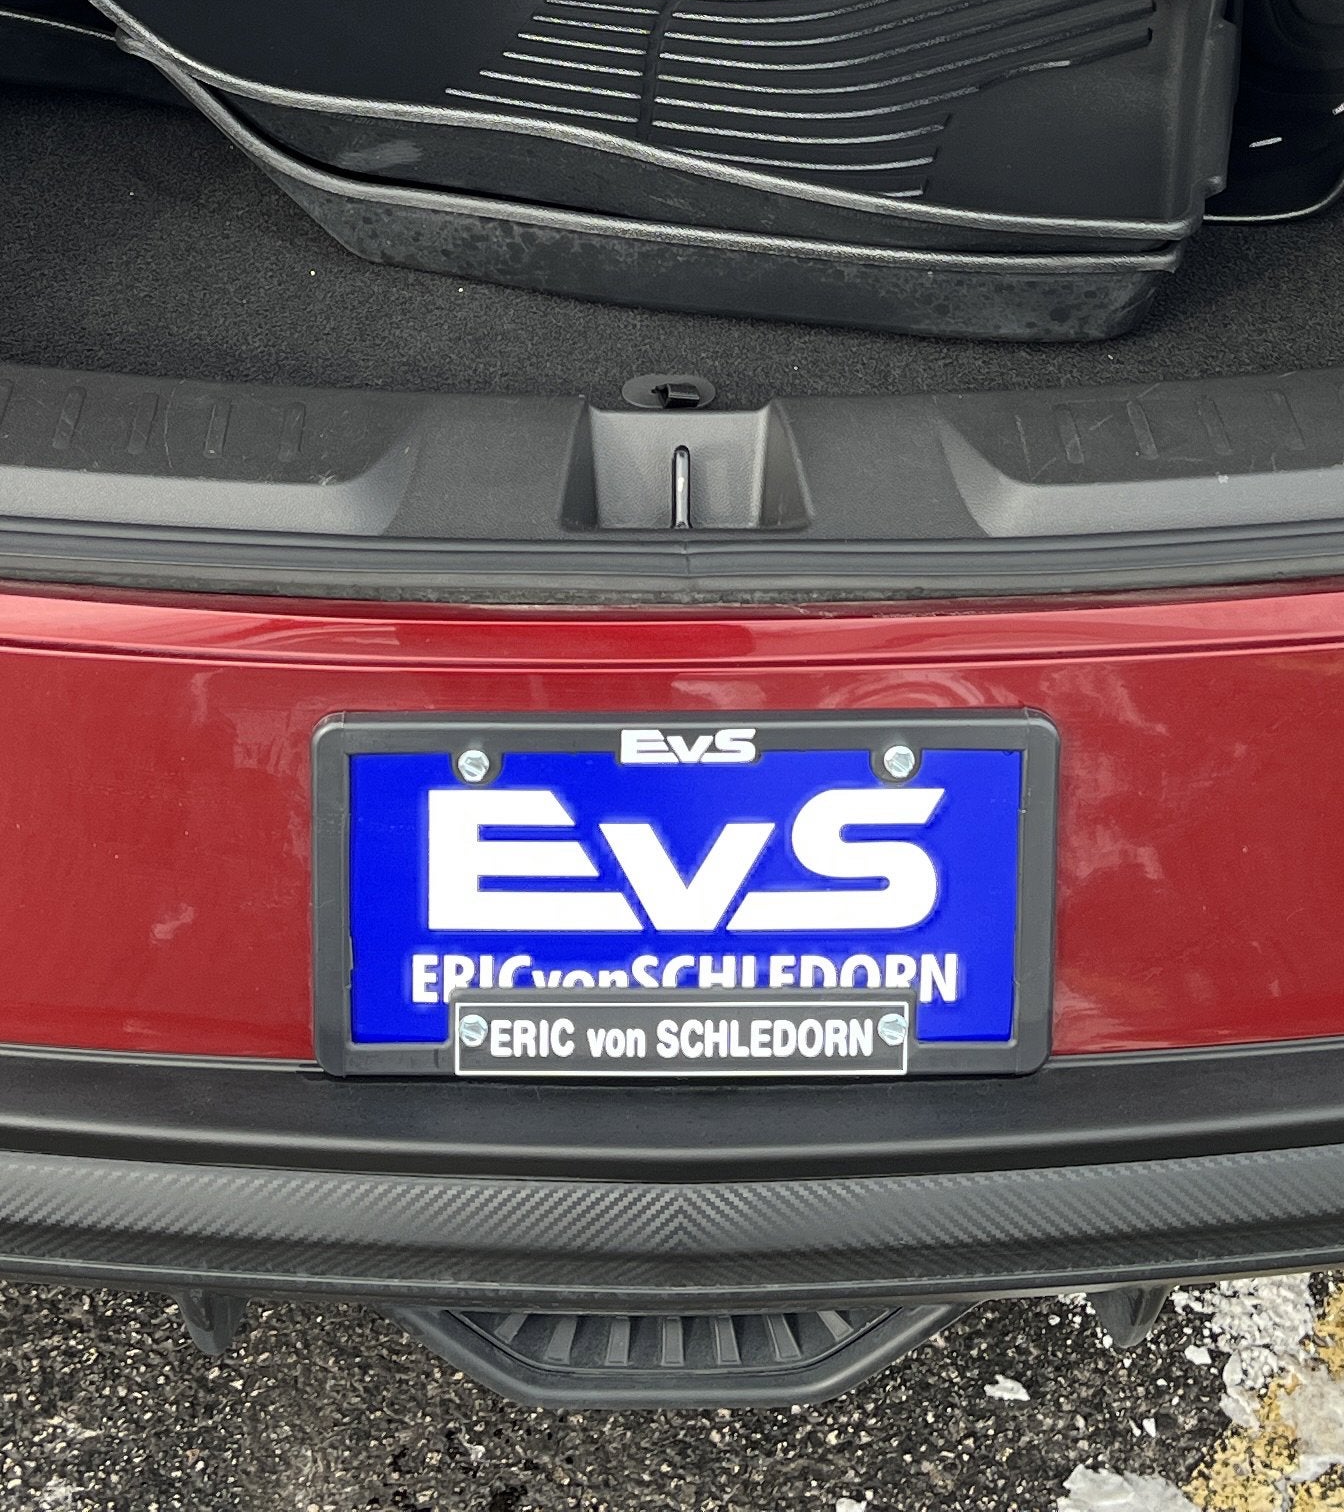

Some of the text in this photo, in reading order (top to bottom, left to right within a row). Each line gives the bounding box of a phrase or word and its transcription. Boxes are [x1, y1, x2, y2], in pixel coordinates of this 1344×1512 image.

[489, 1019, 874, 1058] ERIC von SCHLEDORN
